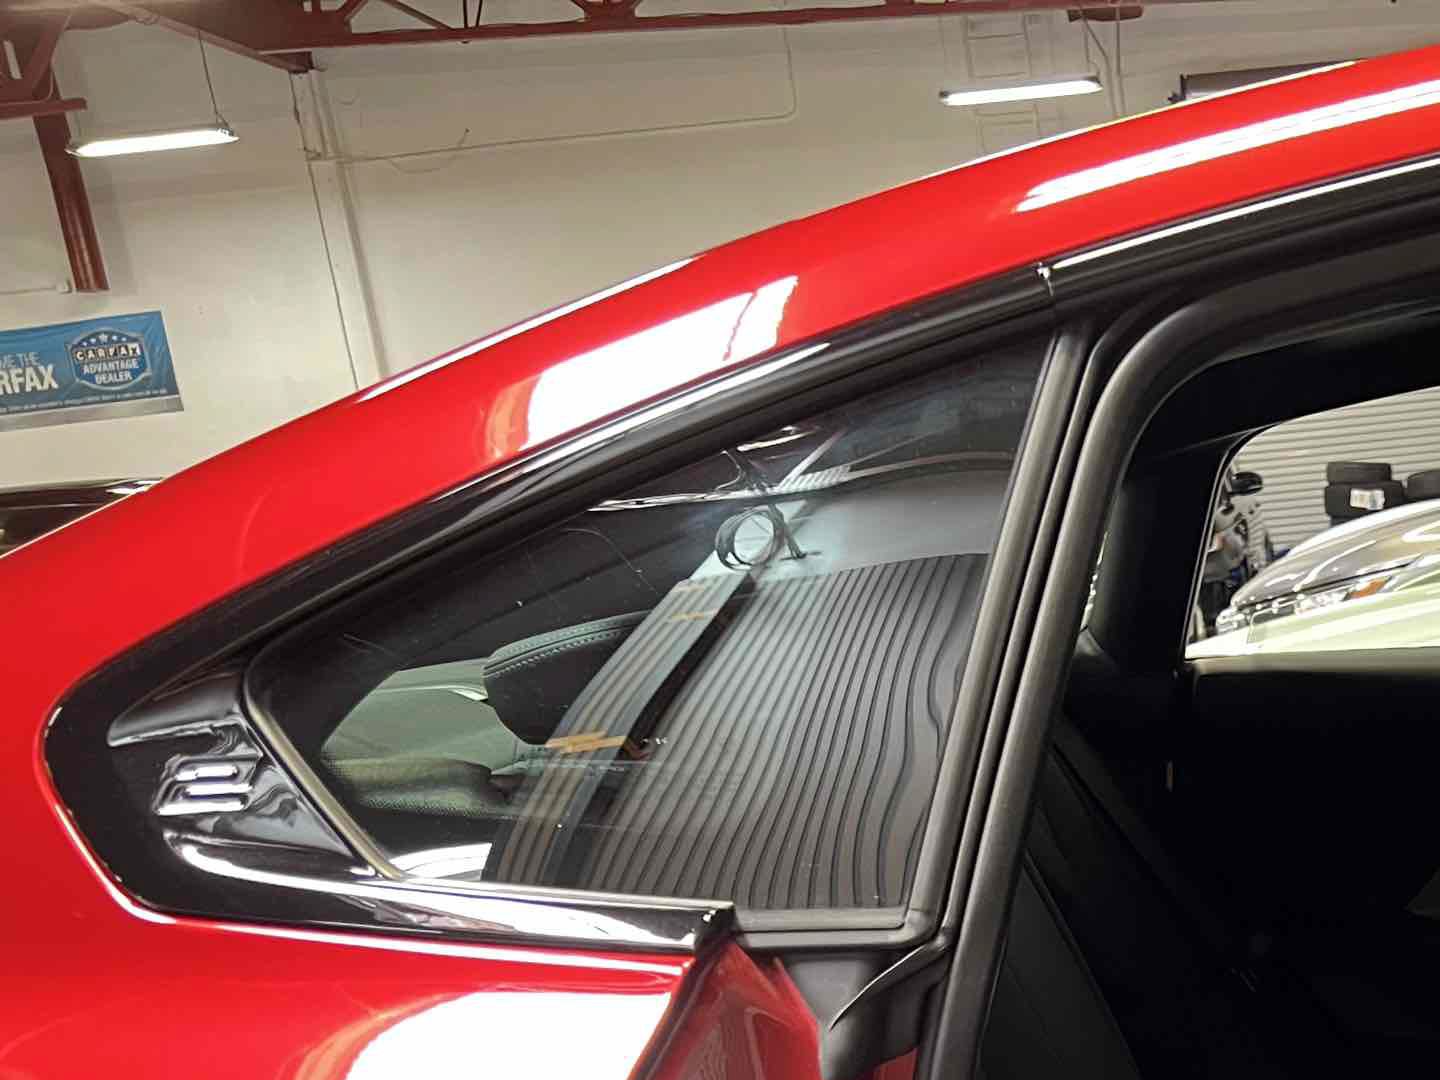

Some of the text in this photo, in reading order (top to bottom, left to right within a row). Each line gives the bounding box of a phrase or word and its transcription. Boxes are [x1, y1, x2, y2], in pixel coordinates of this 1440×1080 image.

[17, 351, 40, 368] THE
[75, 343, 140, 361] CARFAX
[83, 358, 139, 375] ADVANTAGE
[95, 371, 133, 385] DEALER
